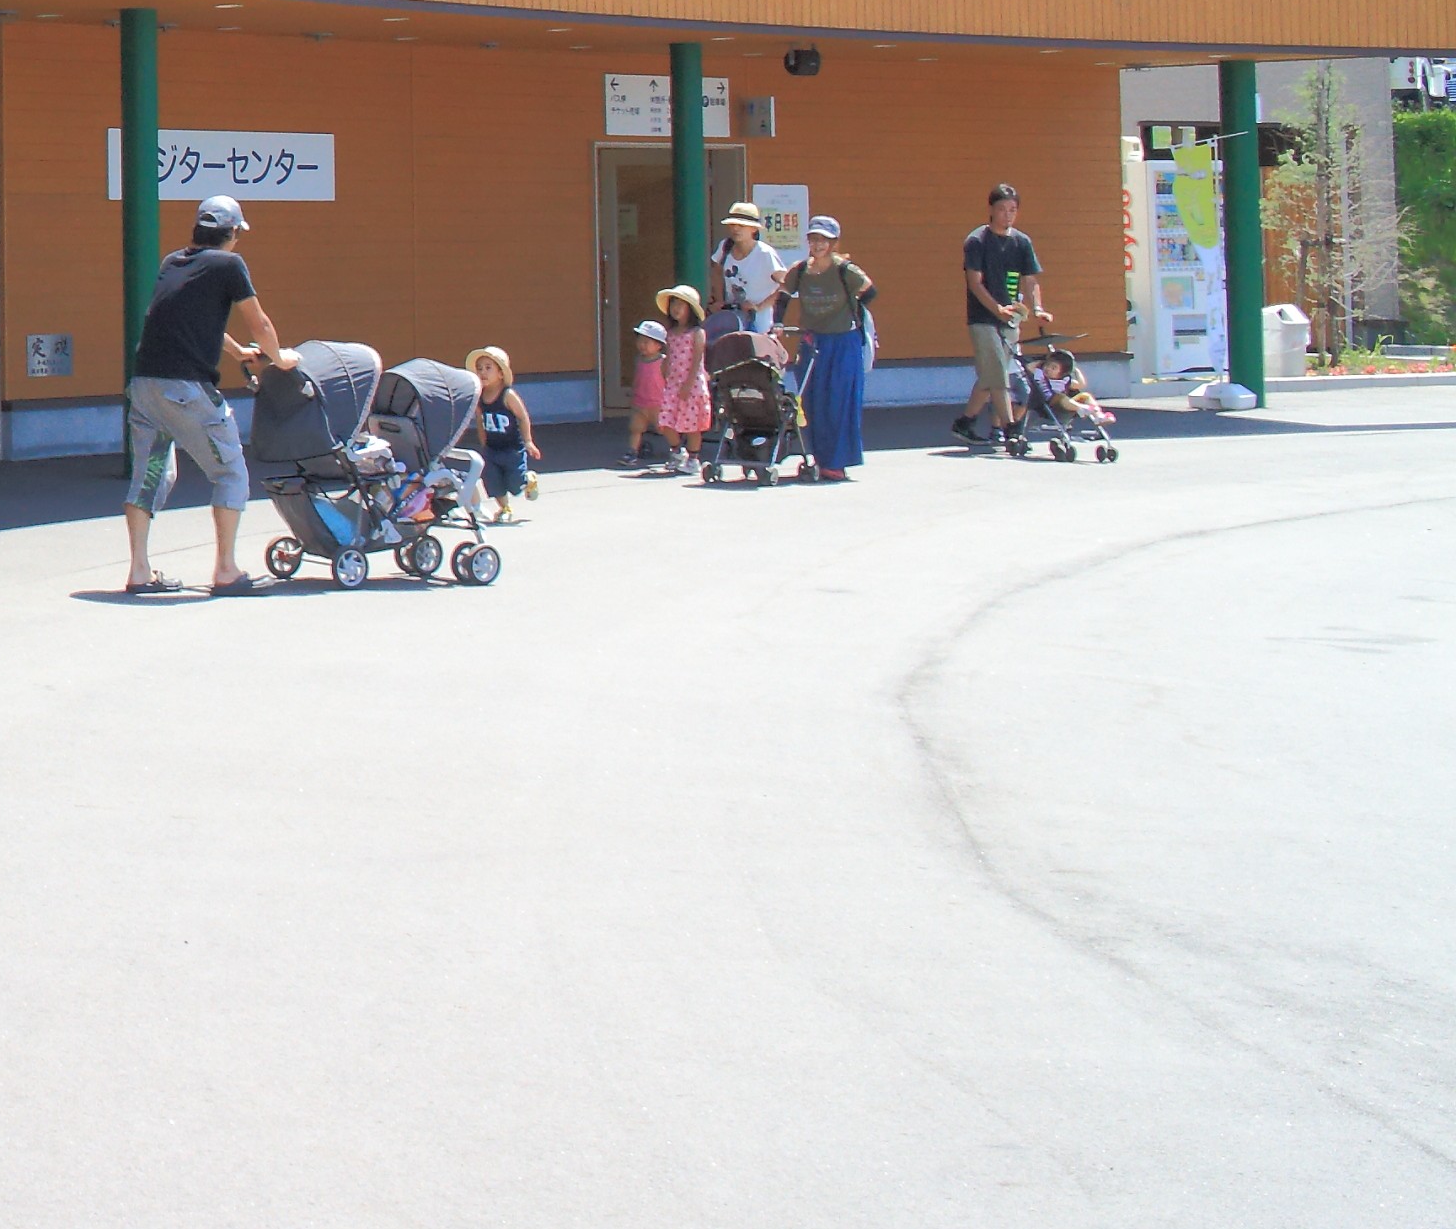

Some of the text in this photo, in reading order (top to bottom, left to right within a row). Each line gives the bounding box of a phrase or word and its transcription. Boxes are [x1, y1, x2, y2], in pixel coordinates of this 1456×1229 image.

[158, 145, 319, 185] ジターセンター
[481, 413, 510, 433] AP
